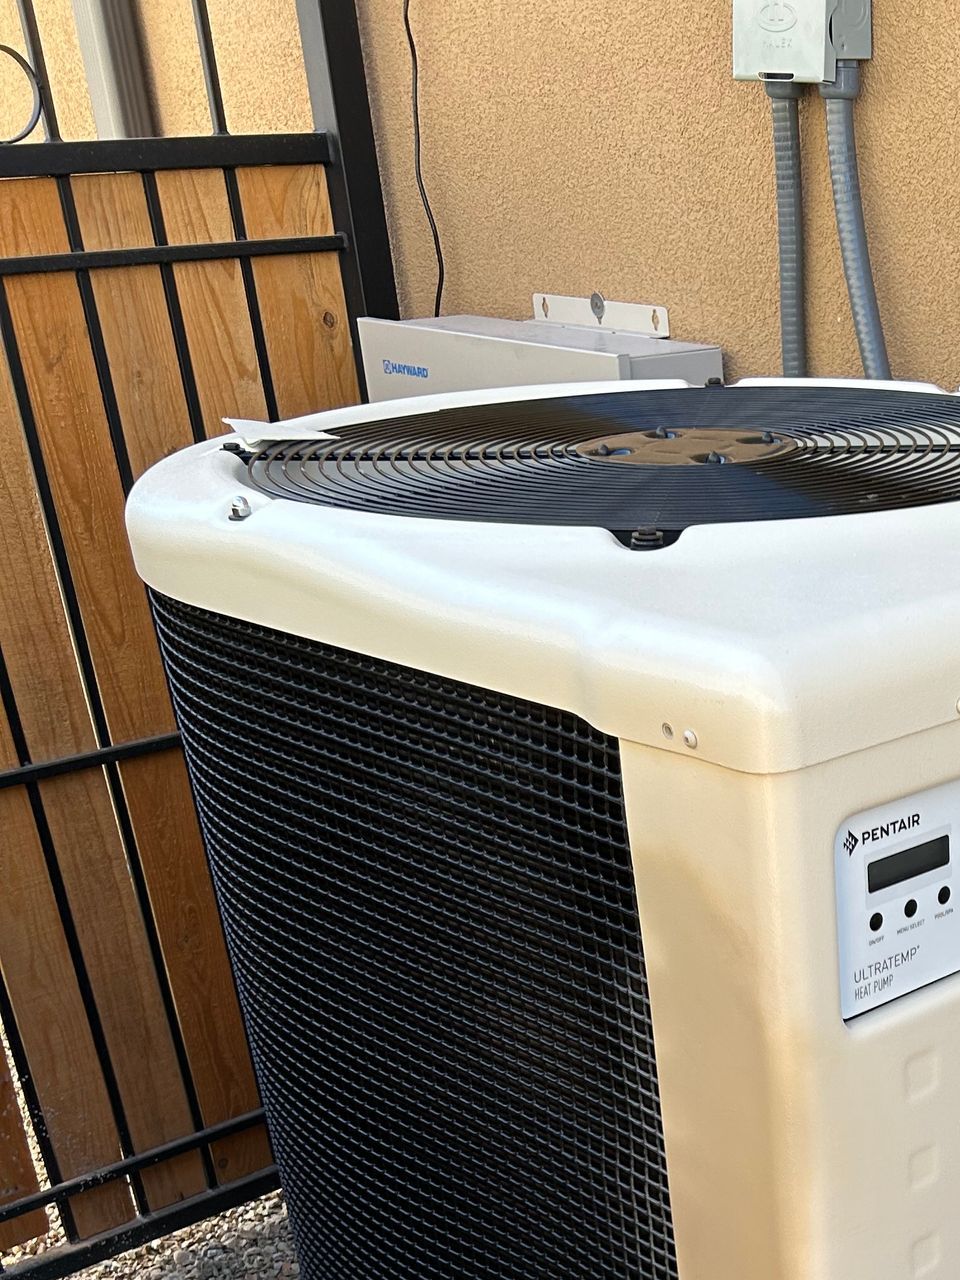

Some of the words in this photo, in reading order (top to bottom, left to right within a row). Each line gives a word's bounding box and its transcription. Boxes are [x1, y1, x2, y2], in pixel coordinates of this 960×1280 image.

[391, 362, 429, 378] HAYWARD
[862, 813, 920, 845] PENTAIR
[854, 983, 872, 1001] HEAT
[873, 974, 894, 994] PUMP
